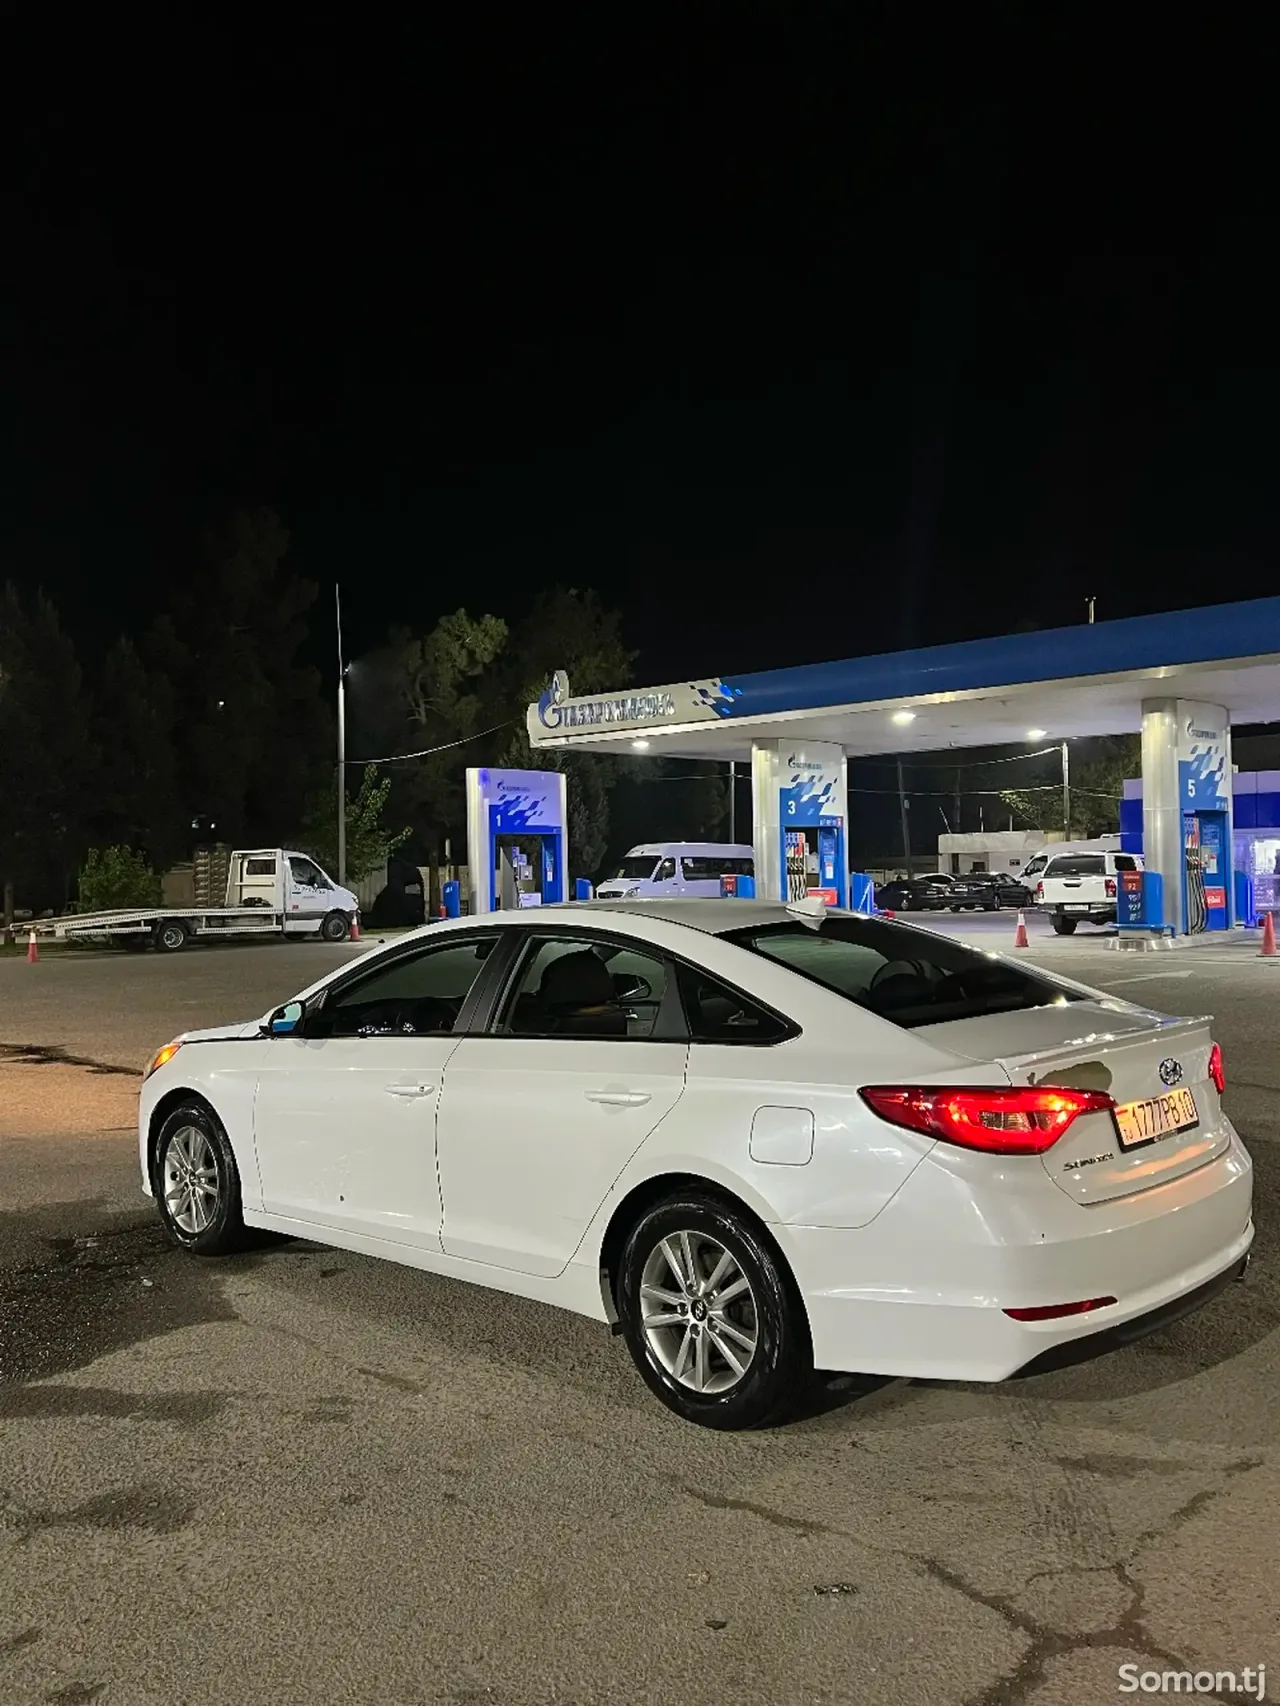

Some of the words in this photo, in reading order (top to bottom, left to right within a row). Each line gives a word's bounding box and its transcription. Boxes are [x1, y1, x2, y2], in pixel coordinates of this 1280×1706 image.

[1188, 779, 1196, 797] 5
[788, 800, 796, 814] 3
[496, 814, 501, 827] 1
